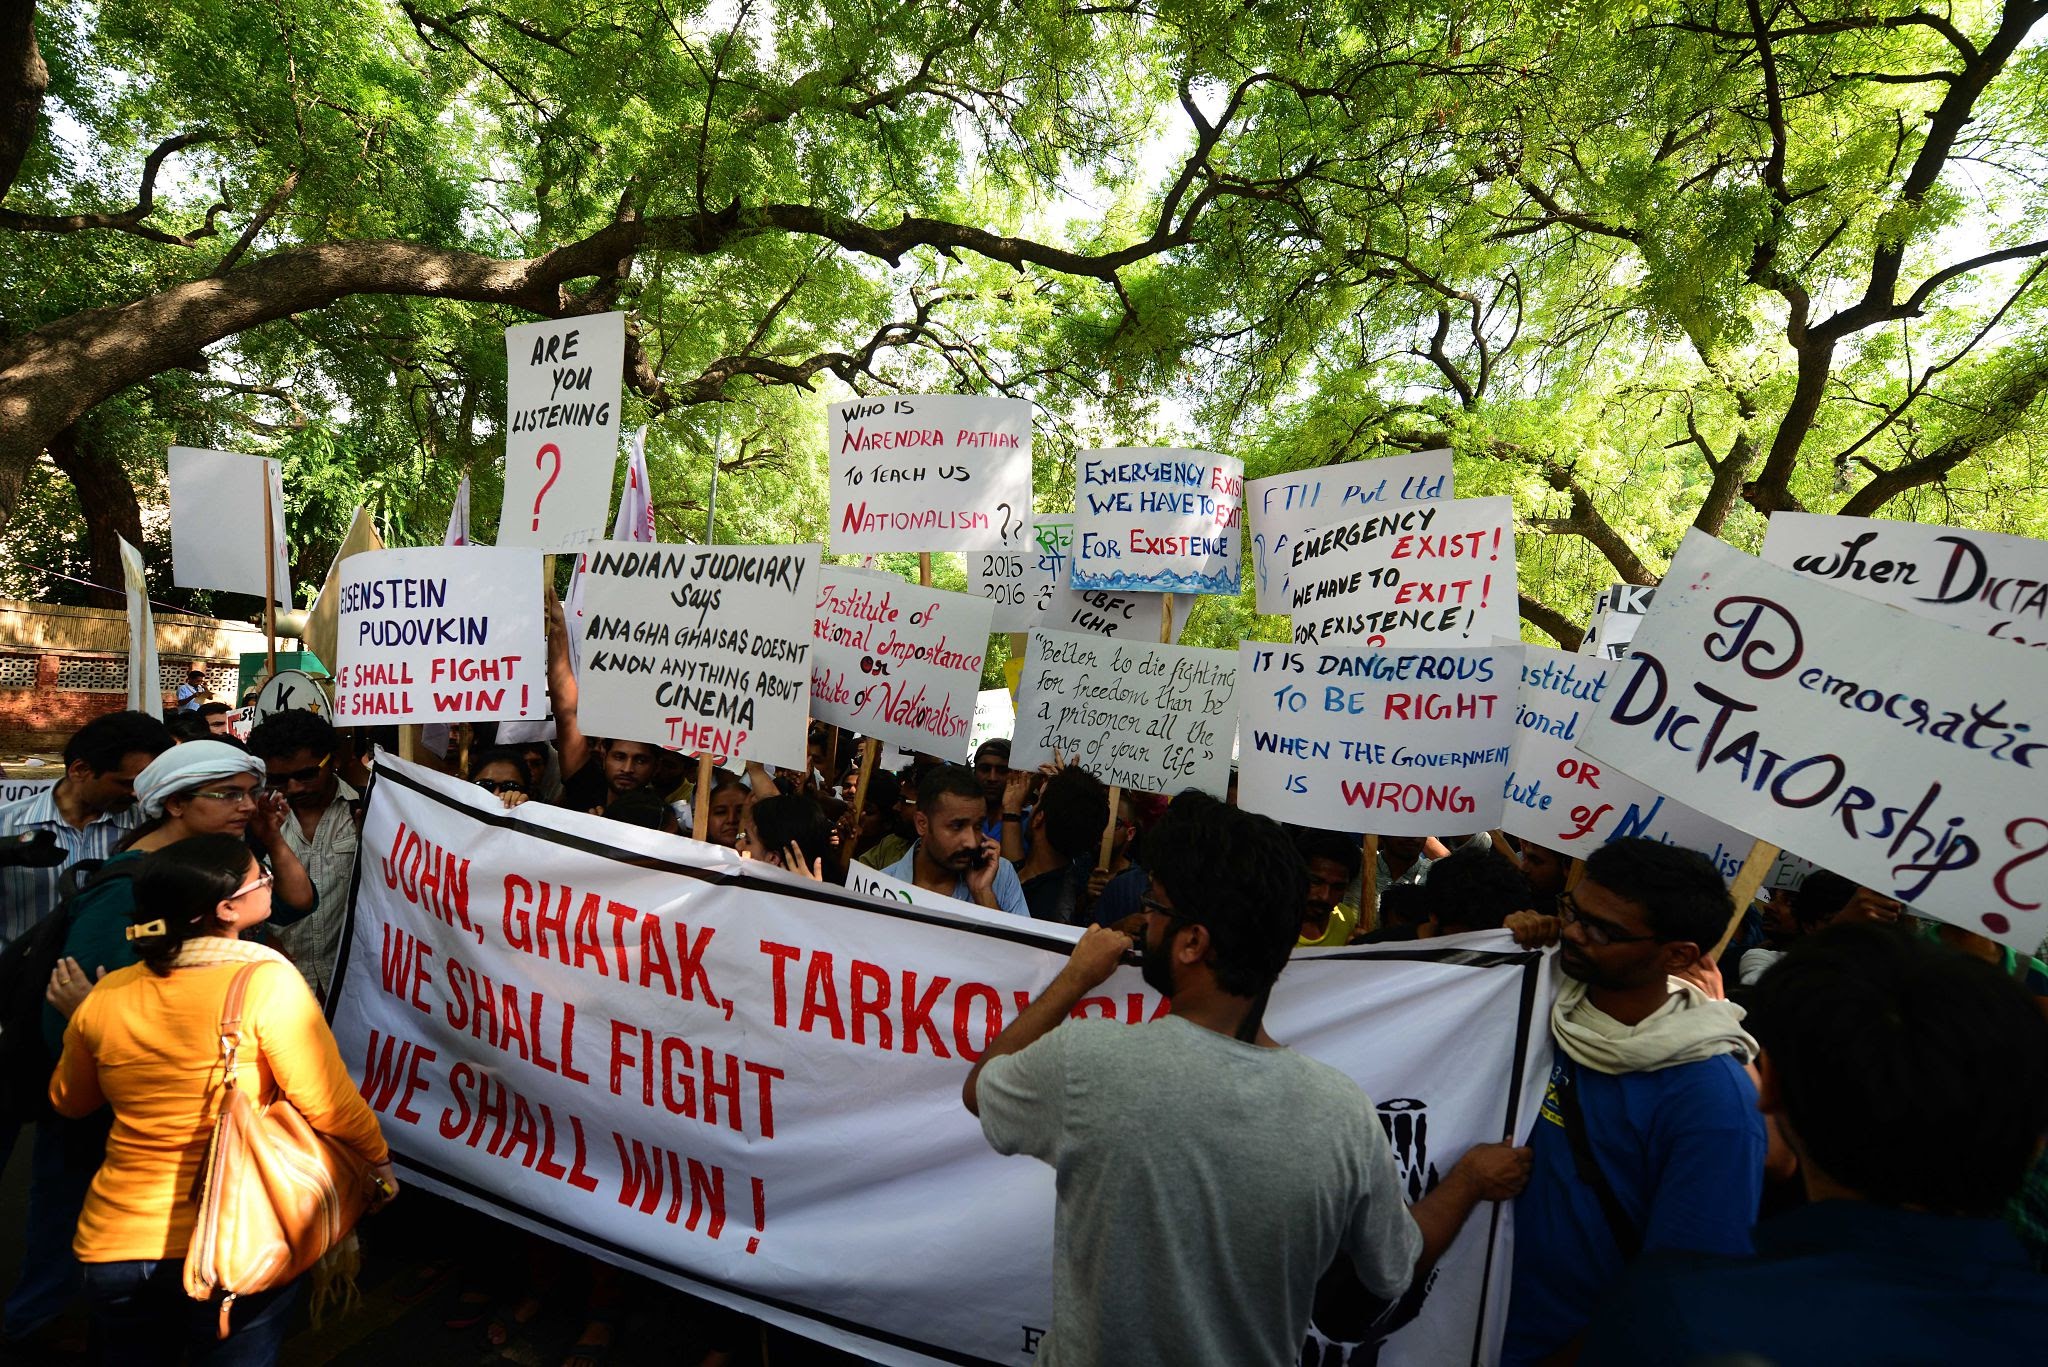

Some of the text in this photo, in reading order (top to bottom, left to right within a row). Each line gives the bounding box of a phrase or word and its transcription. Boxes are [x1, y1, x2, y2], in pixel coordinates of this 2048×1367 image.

[530, 329, 580, 366] ARE
[550, 366, 592, 400] YOU
[512, 402, 610, 434] LISTENING
[841, 401, 915, 423] WHO IS
[841, 426, 944, 454] NARENDRA
[531, 442, 562, 531] ?
[844, 465, 971, 486] TO TEACH US
[1084, 460, 1244, 499] EMERGENCY EXIST
[1400, 475, 1445, 499] Ltd
[841, 501, 989, 535] NATIONALISM
[1087, 491, 1242, 530] WE HAVE TO EXIT
[1082, 528, 1228, 559] FOR EXISTENCE
[1291, 507, 1436, 568] EMERGENCY
[590, 550, 806, 594] INDIAN JUDICIARY
[983, 555, 1023, 578] 2015
[1792, 532, 1920, 585] when
[340, 578, 447, 614] EISENSTEIN
[816, 585, 940, 628] Institute of
[983, 583, 1025, 605] 2016
[1293, 586, 1313, 609] WE
[1315, 571, 1362, 602] HAVE
[1368, 567, 1400, 588] TO
[360, 616, 488, 647] PUDOVKIN
[585, 614, 809, 665] ANAGHA GHAISAS DOESNT
[1294, 621, 1319, 646] FOR
[877, 629, 982, 673] Importance
[1253, 651, 1495, 682] IT IS DANGEROUS
[354, 662, 413, 688] SHALL
[430, 655, 522, 684] FIGHT
[589, 650, 803, 704] KNOW ANYTHING ABOUT
[1110, 646, 1131, 673] to
[1139, 650, 1166, 677] die
[1168, 657, 1237, 703] fighting
[351, 691, 413, 716] SHALL
[433, 688, 506, 713] WIN
[655, 681, 754, 731] CINEMA
[850, 684, 878, 716] of
[872, 679, 969, 738] Nationalism
[1036, 669, 1224, 715] for freedom than be
[1274, 684, 1498, 720] TO BE RIGHT
[665, 717, 748, 757] THEN?
[1037, 702, 1214, 747] a prisoner all the
[1515, 704, 1579, 740] ional
[1039, 725, 1081, 760] days
[1086, 730, 1110, 763] of
[1105, 742, 1150, 771] your
[1254, 730, 1511, 768] WHEN THE GOVERNMENT
[1110, 767, 1168, 793] MARLEY
[1556, 758, 1601, 790] OR
[1285, 774, 1475, 814] IS WRONG
[1558, 803, 1615, 840] of
[382, 822, 1172, 1064] JOHN, GHATAK, TARKO
[381, 923, 784, 1139] WE SHALL FIGHT
[359, 1030, 436, 1125] WE
[439, 1063, 598, 1192] SHALL
[612, 1131, 726, 1240] WIN
